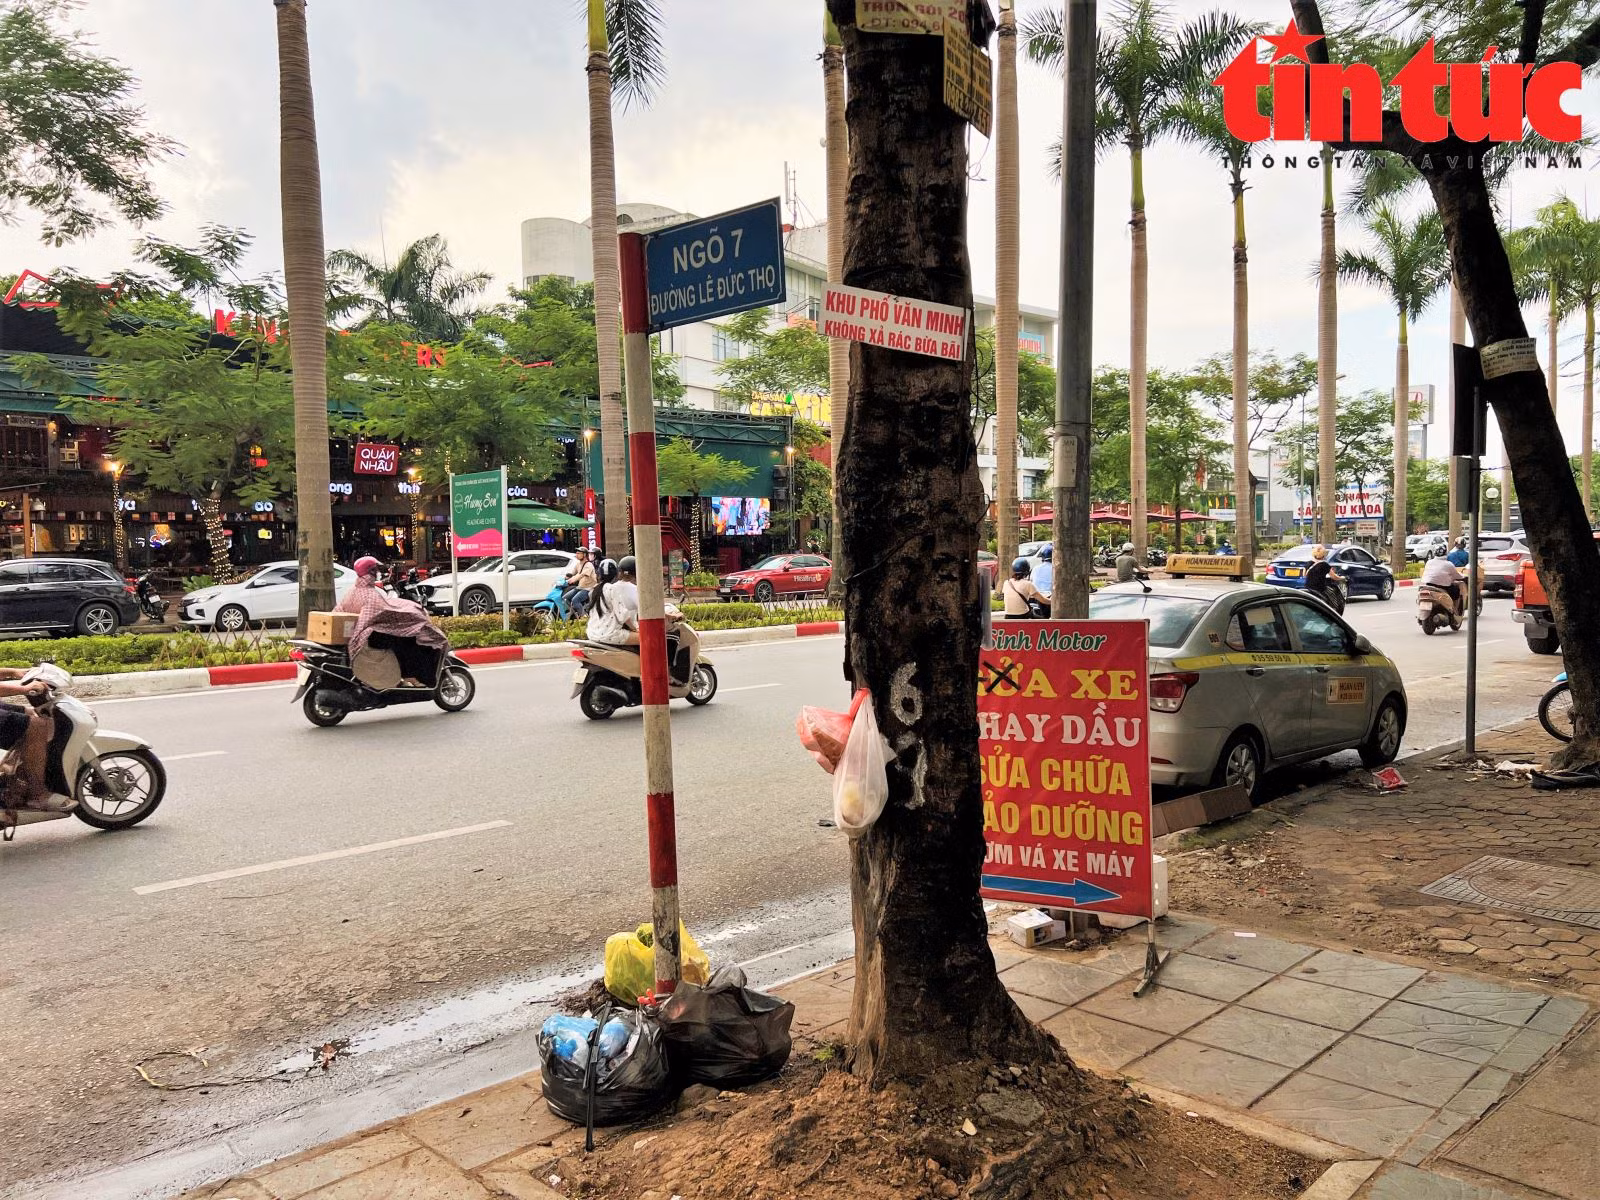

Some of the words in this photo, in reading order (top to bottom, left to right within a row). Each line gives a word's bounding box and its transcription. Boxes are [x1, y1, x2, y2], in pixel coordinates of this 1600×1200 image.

[673, 226, 725, 274] NGÕ
[730, 228, 744, 258] 7
[651, 283, 696, 315] ĐƯỜNG
[699, 275, 715, 304] LÊ
[717, 268, 745, 300] ĐỨC
[748, 265, 776, 293] THỌ
[825, 290, 857, 316] KHU
[859, 295, 890, 322] PHỐ
[893, 302, 923, 328] VĂN
[925, 310, 966, 336] MINH
[824, 319, 866, 341] KHÔNG
[868, 325, 885, 345] XẢ
[887, 331, 912, 350] RÁC
[914, 335, 938, 355] BỪA
[941, 341, 961, 360] BÃI
[360, 460, 393, 473] NHẬU
[361, 448, 395, 460] QUÁN
[508, 485, 528, 497] của
[555, 487, 567, 497] ta
[989, 629, 1032, 651] Sinh
[1035, 629, 1108, 652] Motor
[1070, 669, 1139, 700] XE
[977, 711, 1051, 742] HAY
[1061, 702, 1141, 747] DẦU
[1040, 754, 1132, 796] CHỮA
[983, 789, 1020, 834] ẢO
[1030, 800, 1144, 846] DƯỠNG
[983, 841, 1013, 865] ƠM
[1019, 842, 1047, 869] VÁ
[1052, 849, 1080, 872] XE
[1086, 850, 1135, 878] MÁY
